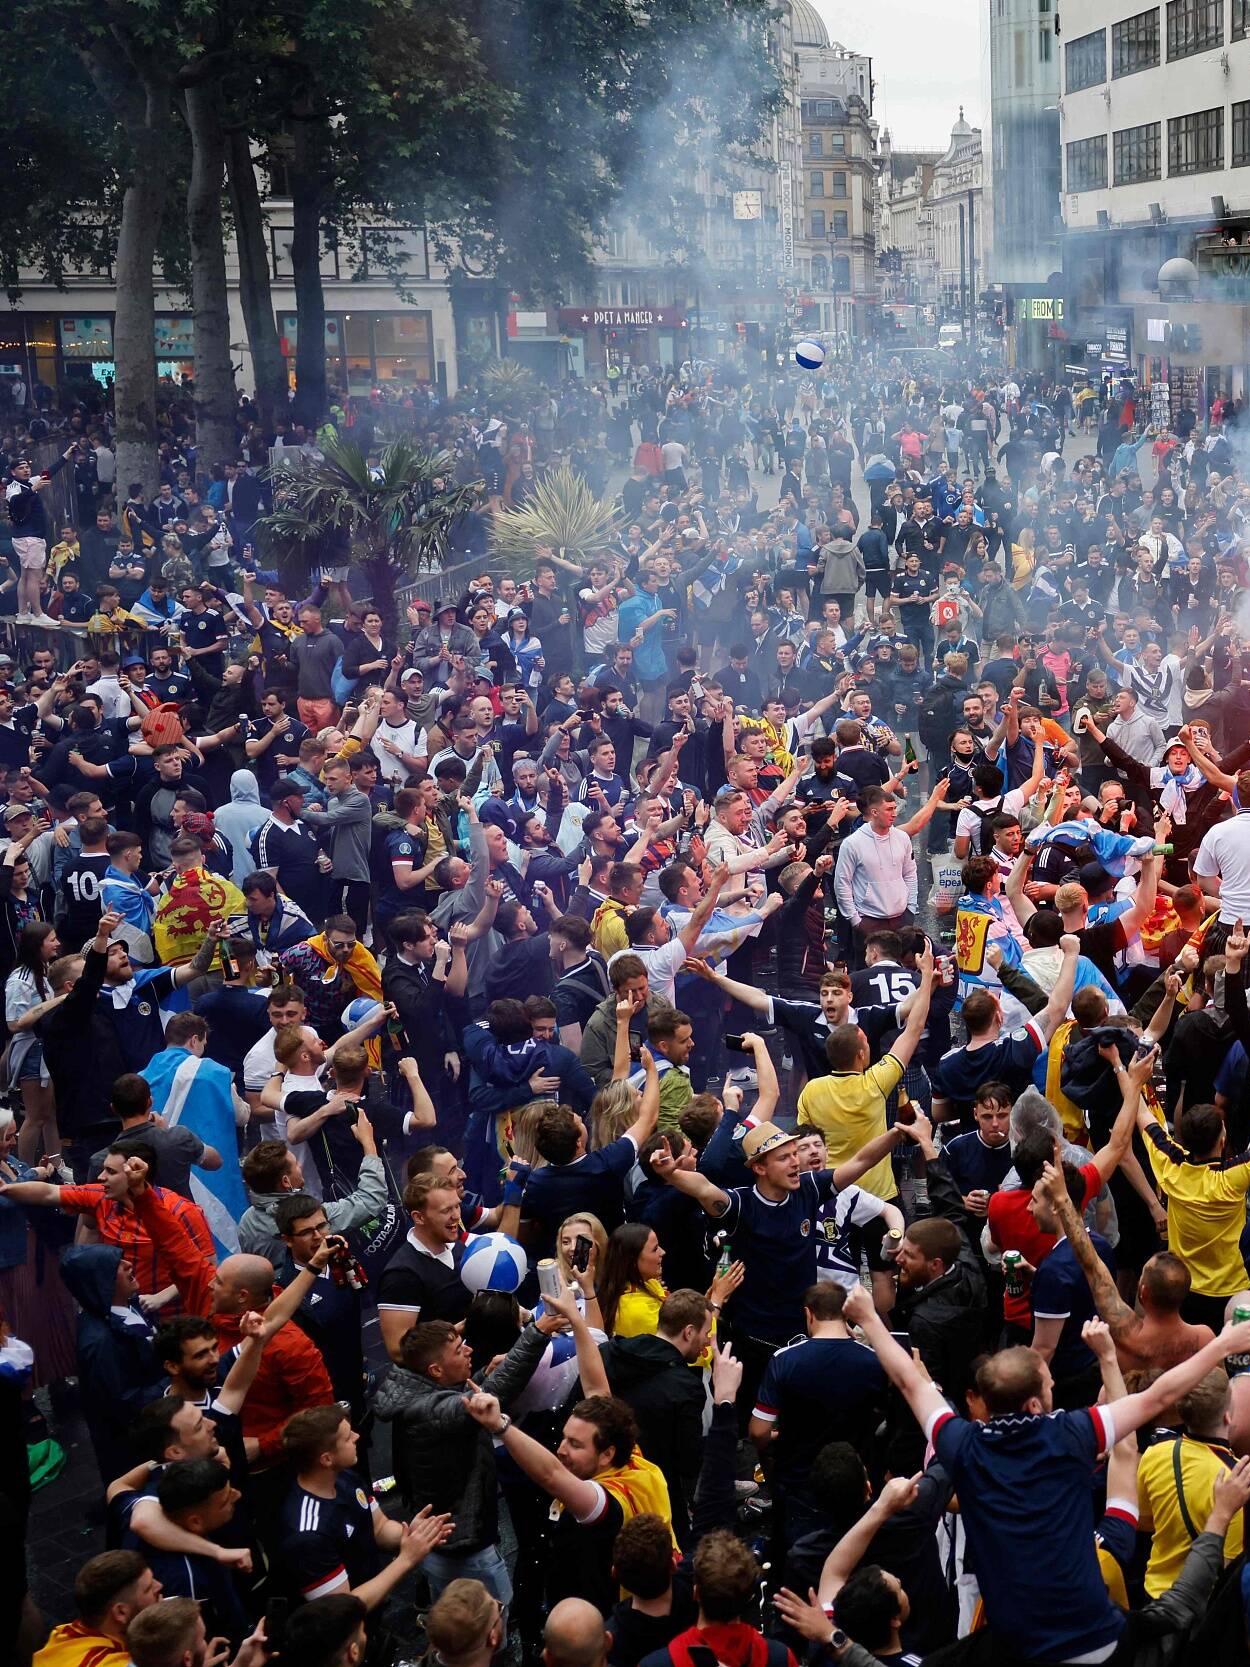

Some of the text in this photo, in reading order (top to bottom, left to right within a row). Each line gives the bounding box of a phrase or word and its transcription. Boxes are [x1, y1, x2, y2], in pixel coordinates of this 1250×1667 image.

[784, 227, 793, 269] MORMON
[616, 311, 622, 325] A
[1033, 301, 1053, 317] FROM
[67, 871, 97, 901] 10
[869, 972, 918, 1003] 15
